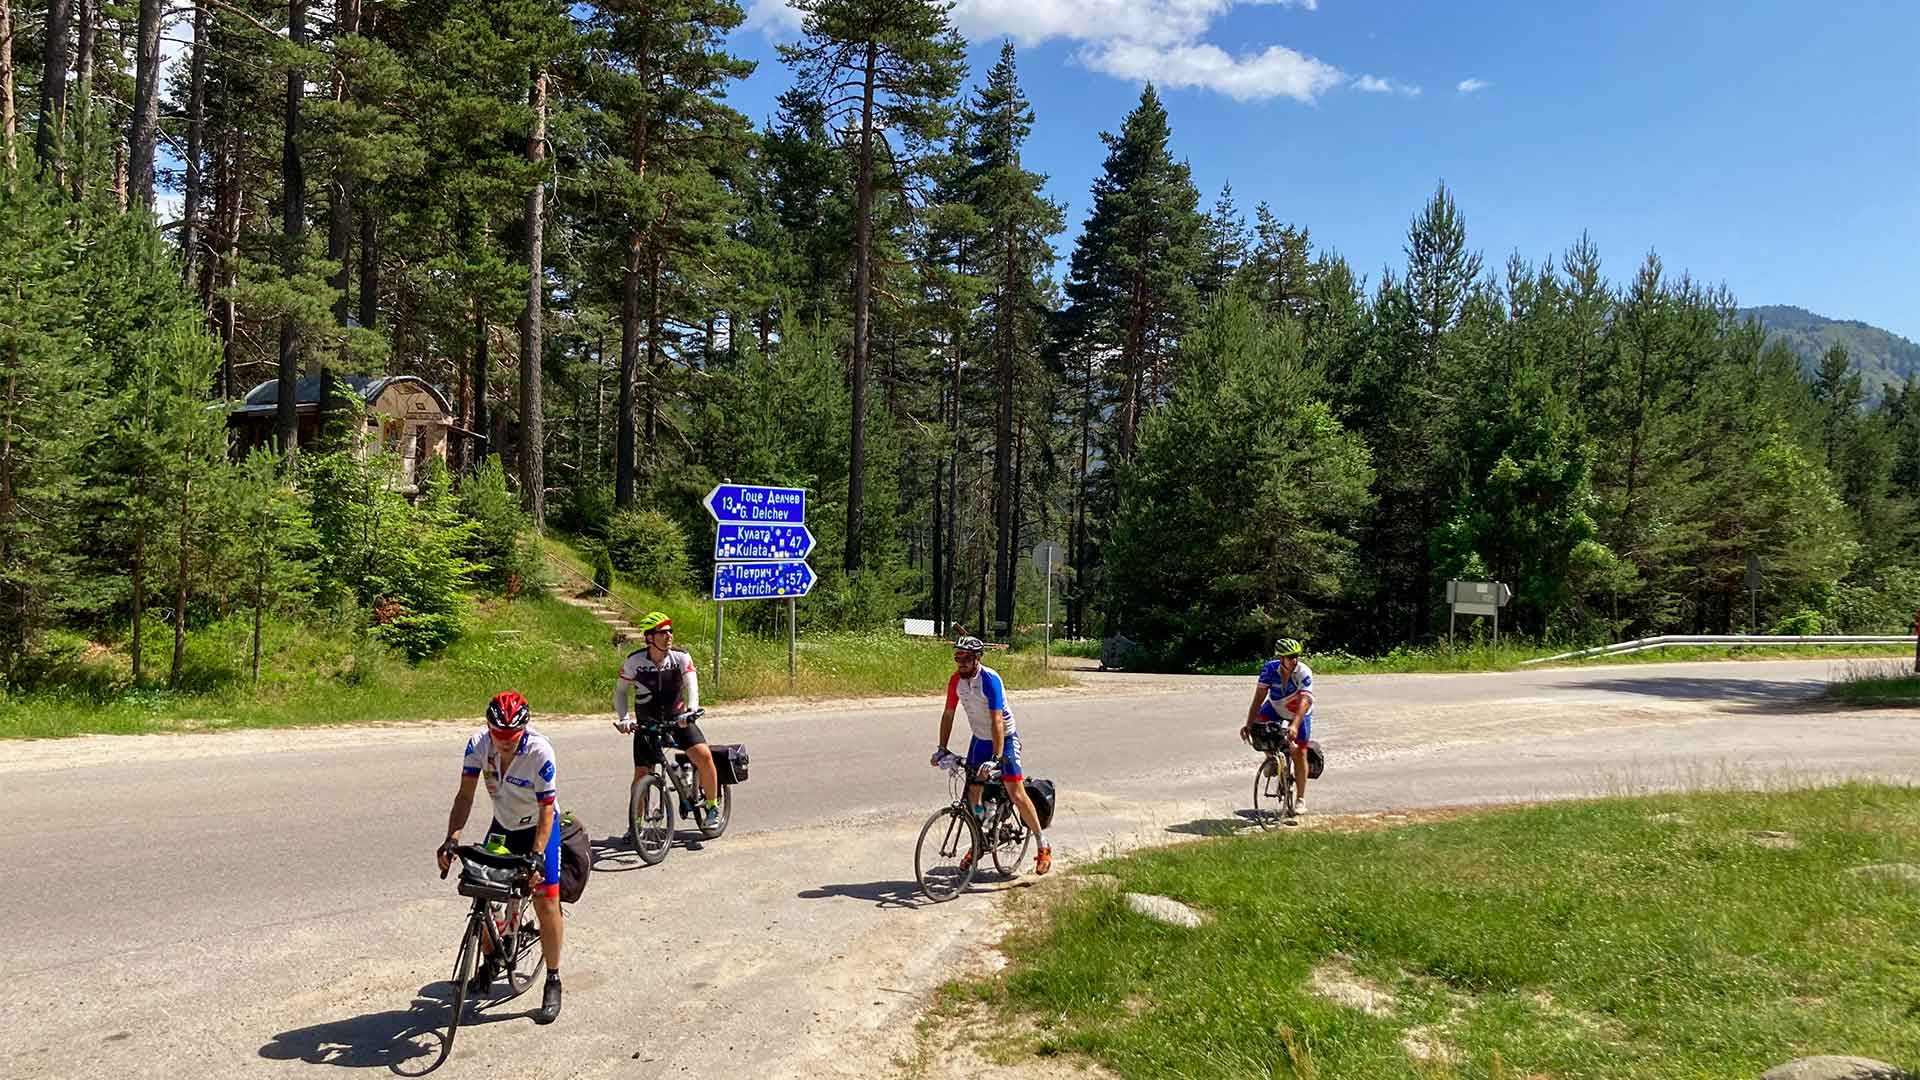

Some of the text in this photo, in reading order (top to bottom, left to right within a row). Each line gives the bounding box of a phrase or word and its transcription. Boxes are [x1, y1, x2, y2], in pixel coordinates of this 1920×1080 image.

[722, 497, 733, 510] 13
[741, 489, 800, 505] Гоце Делчев
[752, 507, 789, 520] Delchev
[737, 527, 771, 543] Кулата
[790, 537, 802, 549] 47
[736, 544, 768, 556] Kulata
[736, 566, 772, 581] Петрич
[790, 573, 802, 585] 57
[735, 583, 772, 595] Petrich
